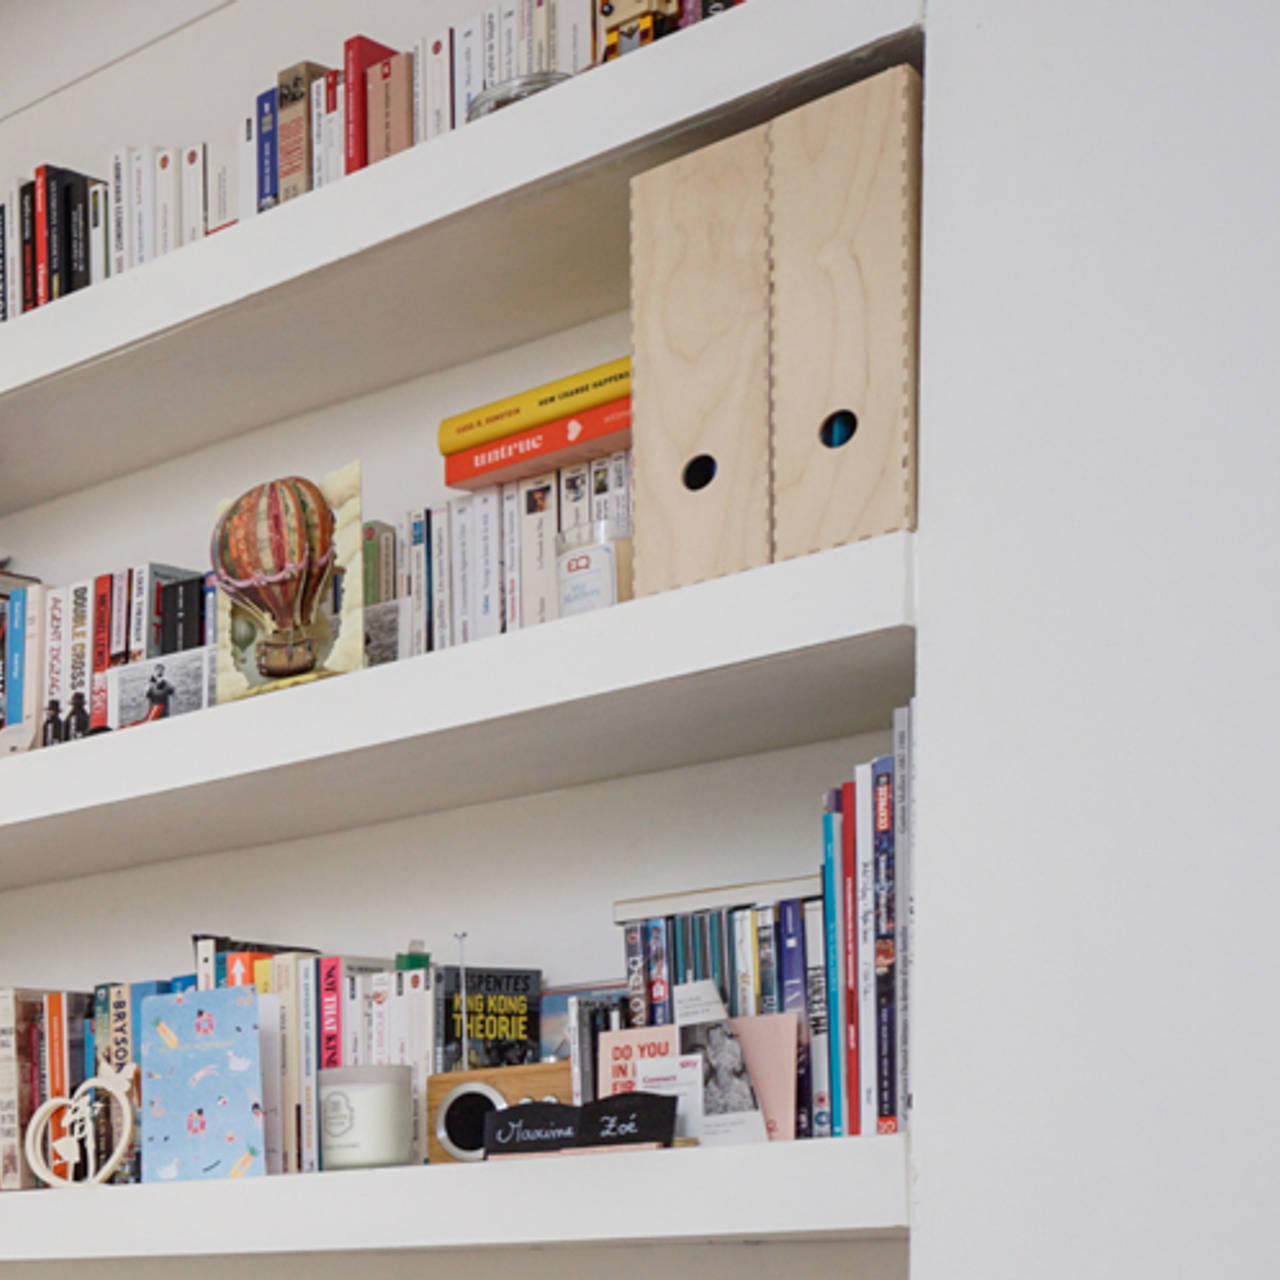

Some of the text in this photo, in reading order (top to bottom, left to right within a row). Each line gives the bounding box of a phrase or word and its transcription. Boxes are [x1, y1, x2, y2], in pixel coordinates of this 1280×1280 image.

[70, 586, 88, 691] DOUBLE CROSS
[325, 965, 337, 992] NOT
[324, 995, 337, 1032] THAT
[487, 994, 528, 1015] KONG
[611, 1042, 669, 1061] DO YOU
[601, 1113, 638, 1137] Zoé
